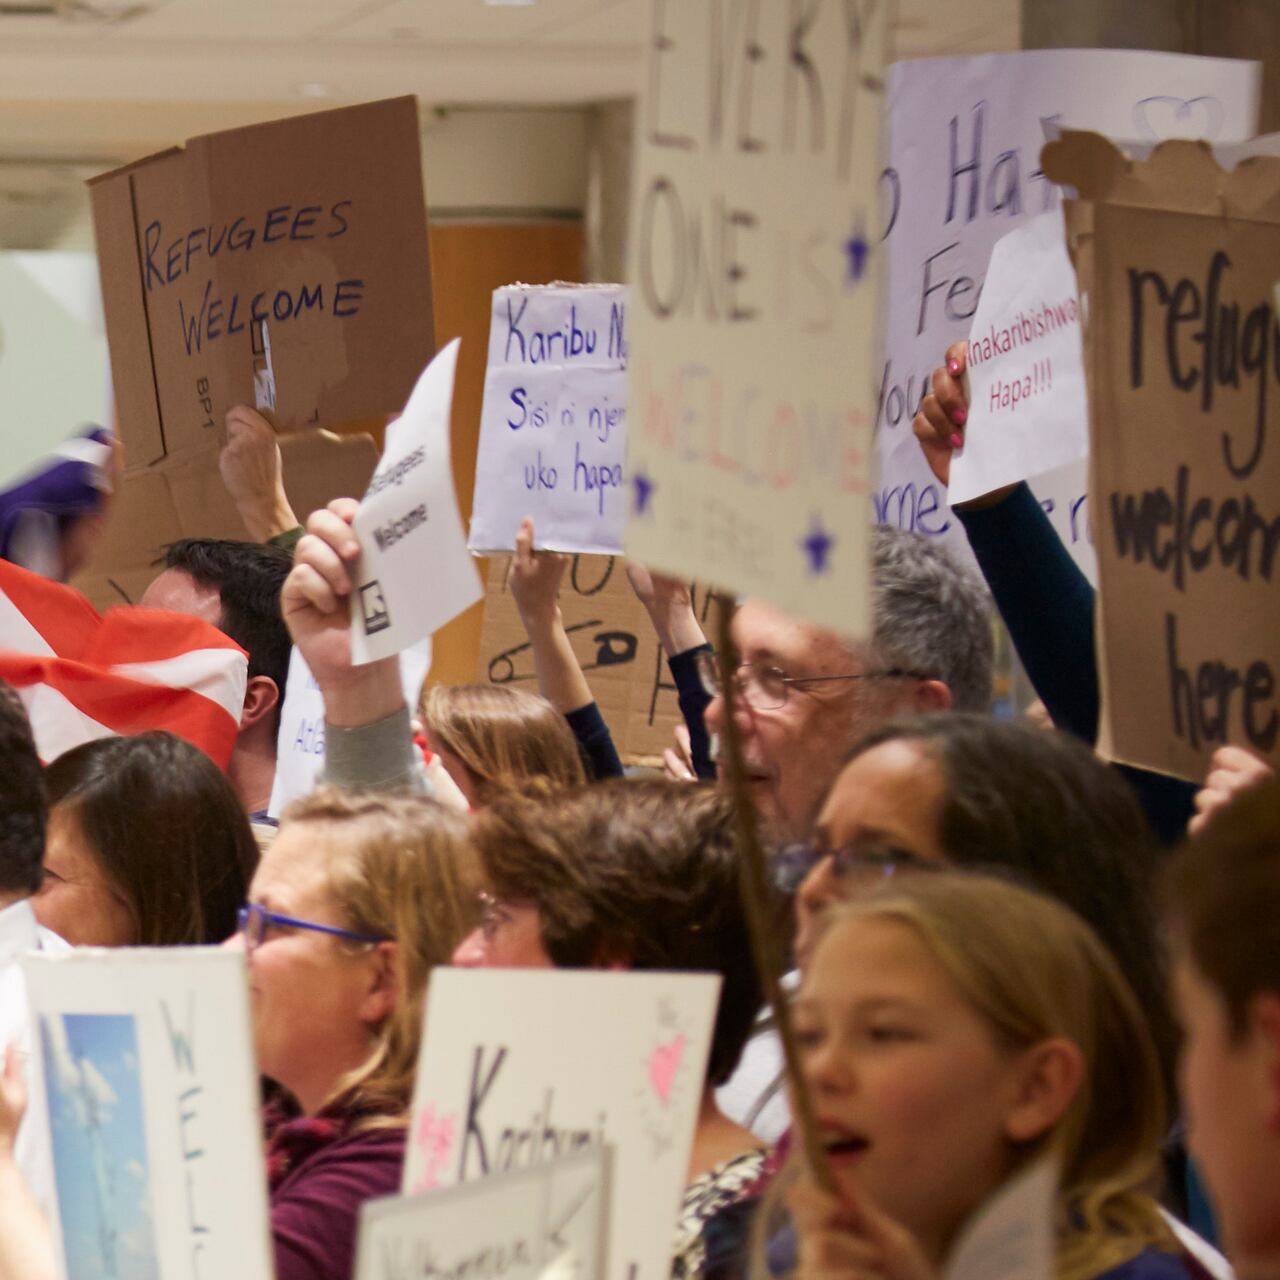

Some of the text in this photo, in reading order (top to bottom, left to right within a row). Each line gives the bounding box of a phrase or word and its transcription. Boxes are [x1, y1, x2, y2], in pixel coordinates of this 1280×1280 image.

[144, 200, 353, 290] REFUGEES
[178, 279, 366, 356] WELCOME
[504, 296, 598, 365] Karibu
[990, 356, 1053, 413] Hapa!!!
[1128, 250, 1280, 480] refug
[524, 450, 558, 490] uko
[372, 502, 428, 553] Welcome
[1166, 611, 1278, 753] here
